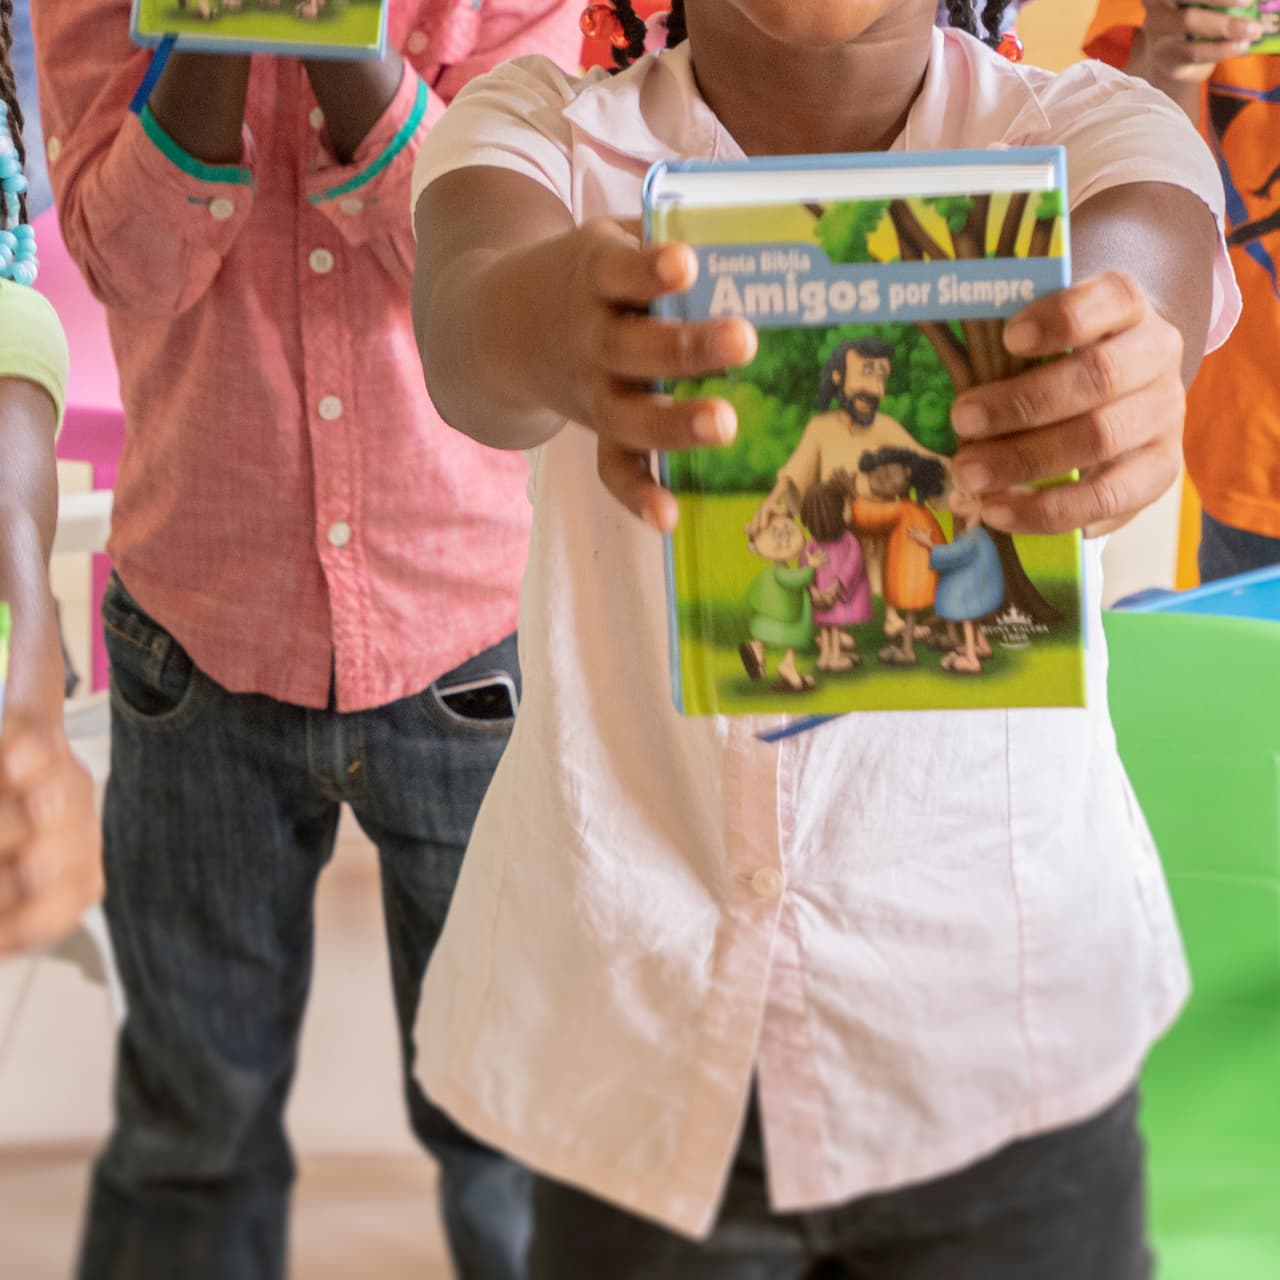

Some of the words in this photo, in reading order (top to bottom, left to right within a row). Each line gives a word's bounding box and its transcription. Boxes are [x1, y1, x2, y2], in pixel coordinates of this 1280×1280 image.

[708, 251, 757, 274] Santa
[760, 249, 811, 274] Biblia
[709, 270, 881, 323] Amigos
[888, 281, 932, 313] por
[937, 273, 1035, 308] Siempre
